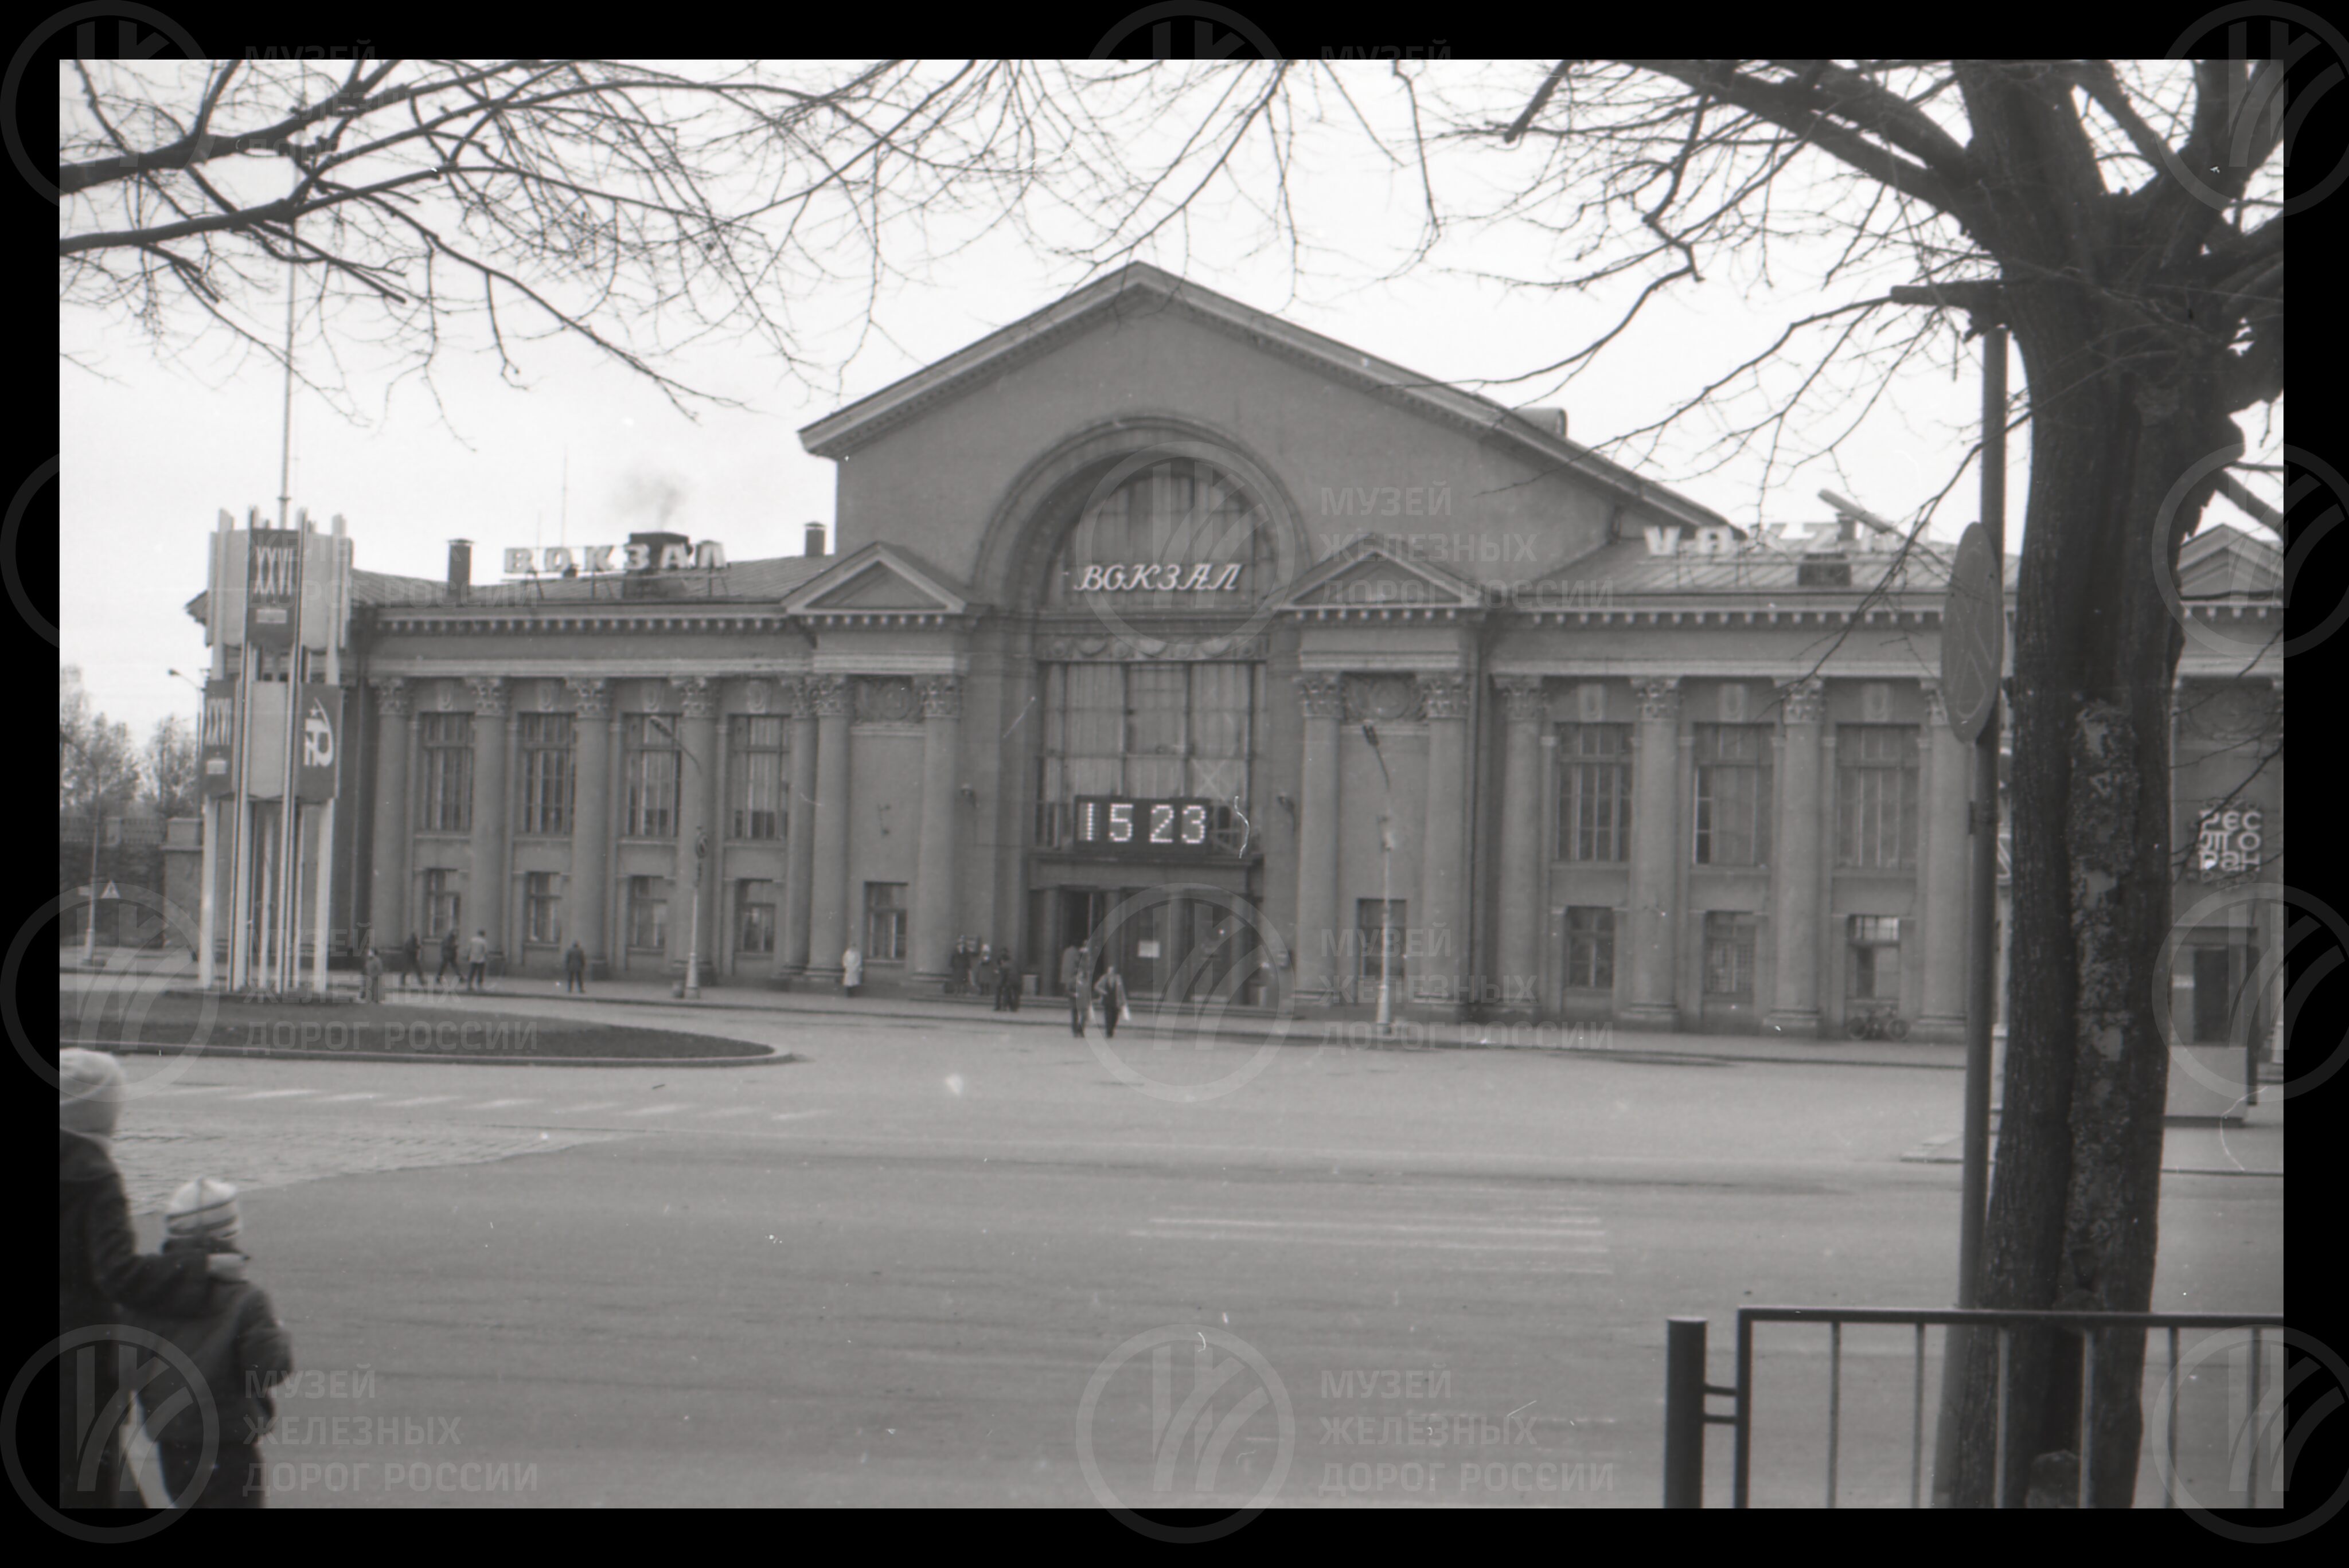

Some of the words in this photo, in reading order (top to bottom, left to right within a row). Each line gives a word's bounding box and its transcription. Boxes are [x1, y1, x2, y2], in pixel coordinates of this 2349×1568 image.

[1642, 522, 1948, 556] VAKZ
[504, 543, 726, 573] ВОКЗАЛ
[1073, 563, 1242, 591] ВОКЗАЛ
[1085, 802, 1134, 843] 15
[1149, 804, 1206, 845] 23
